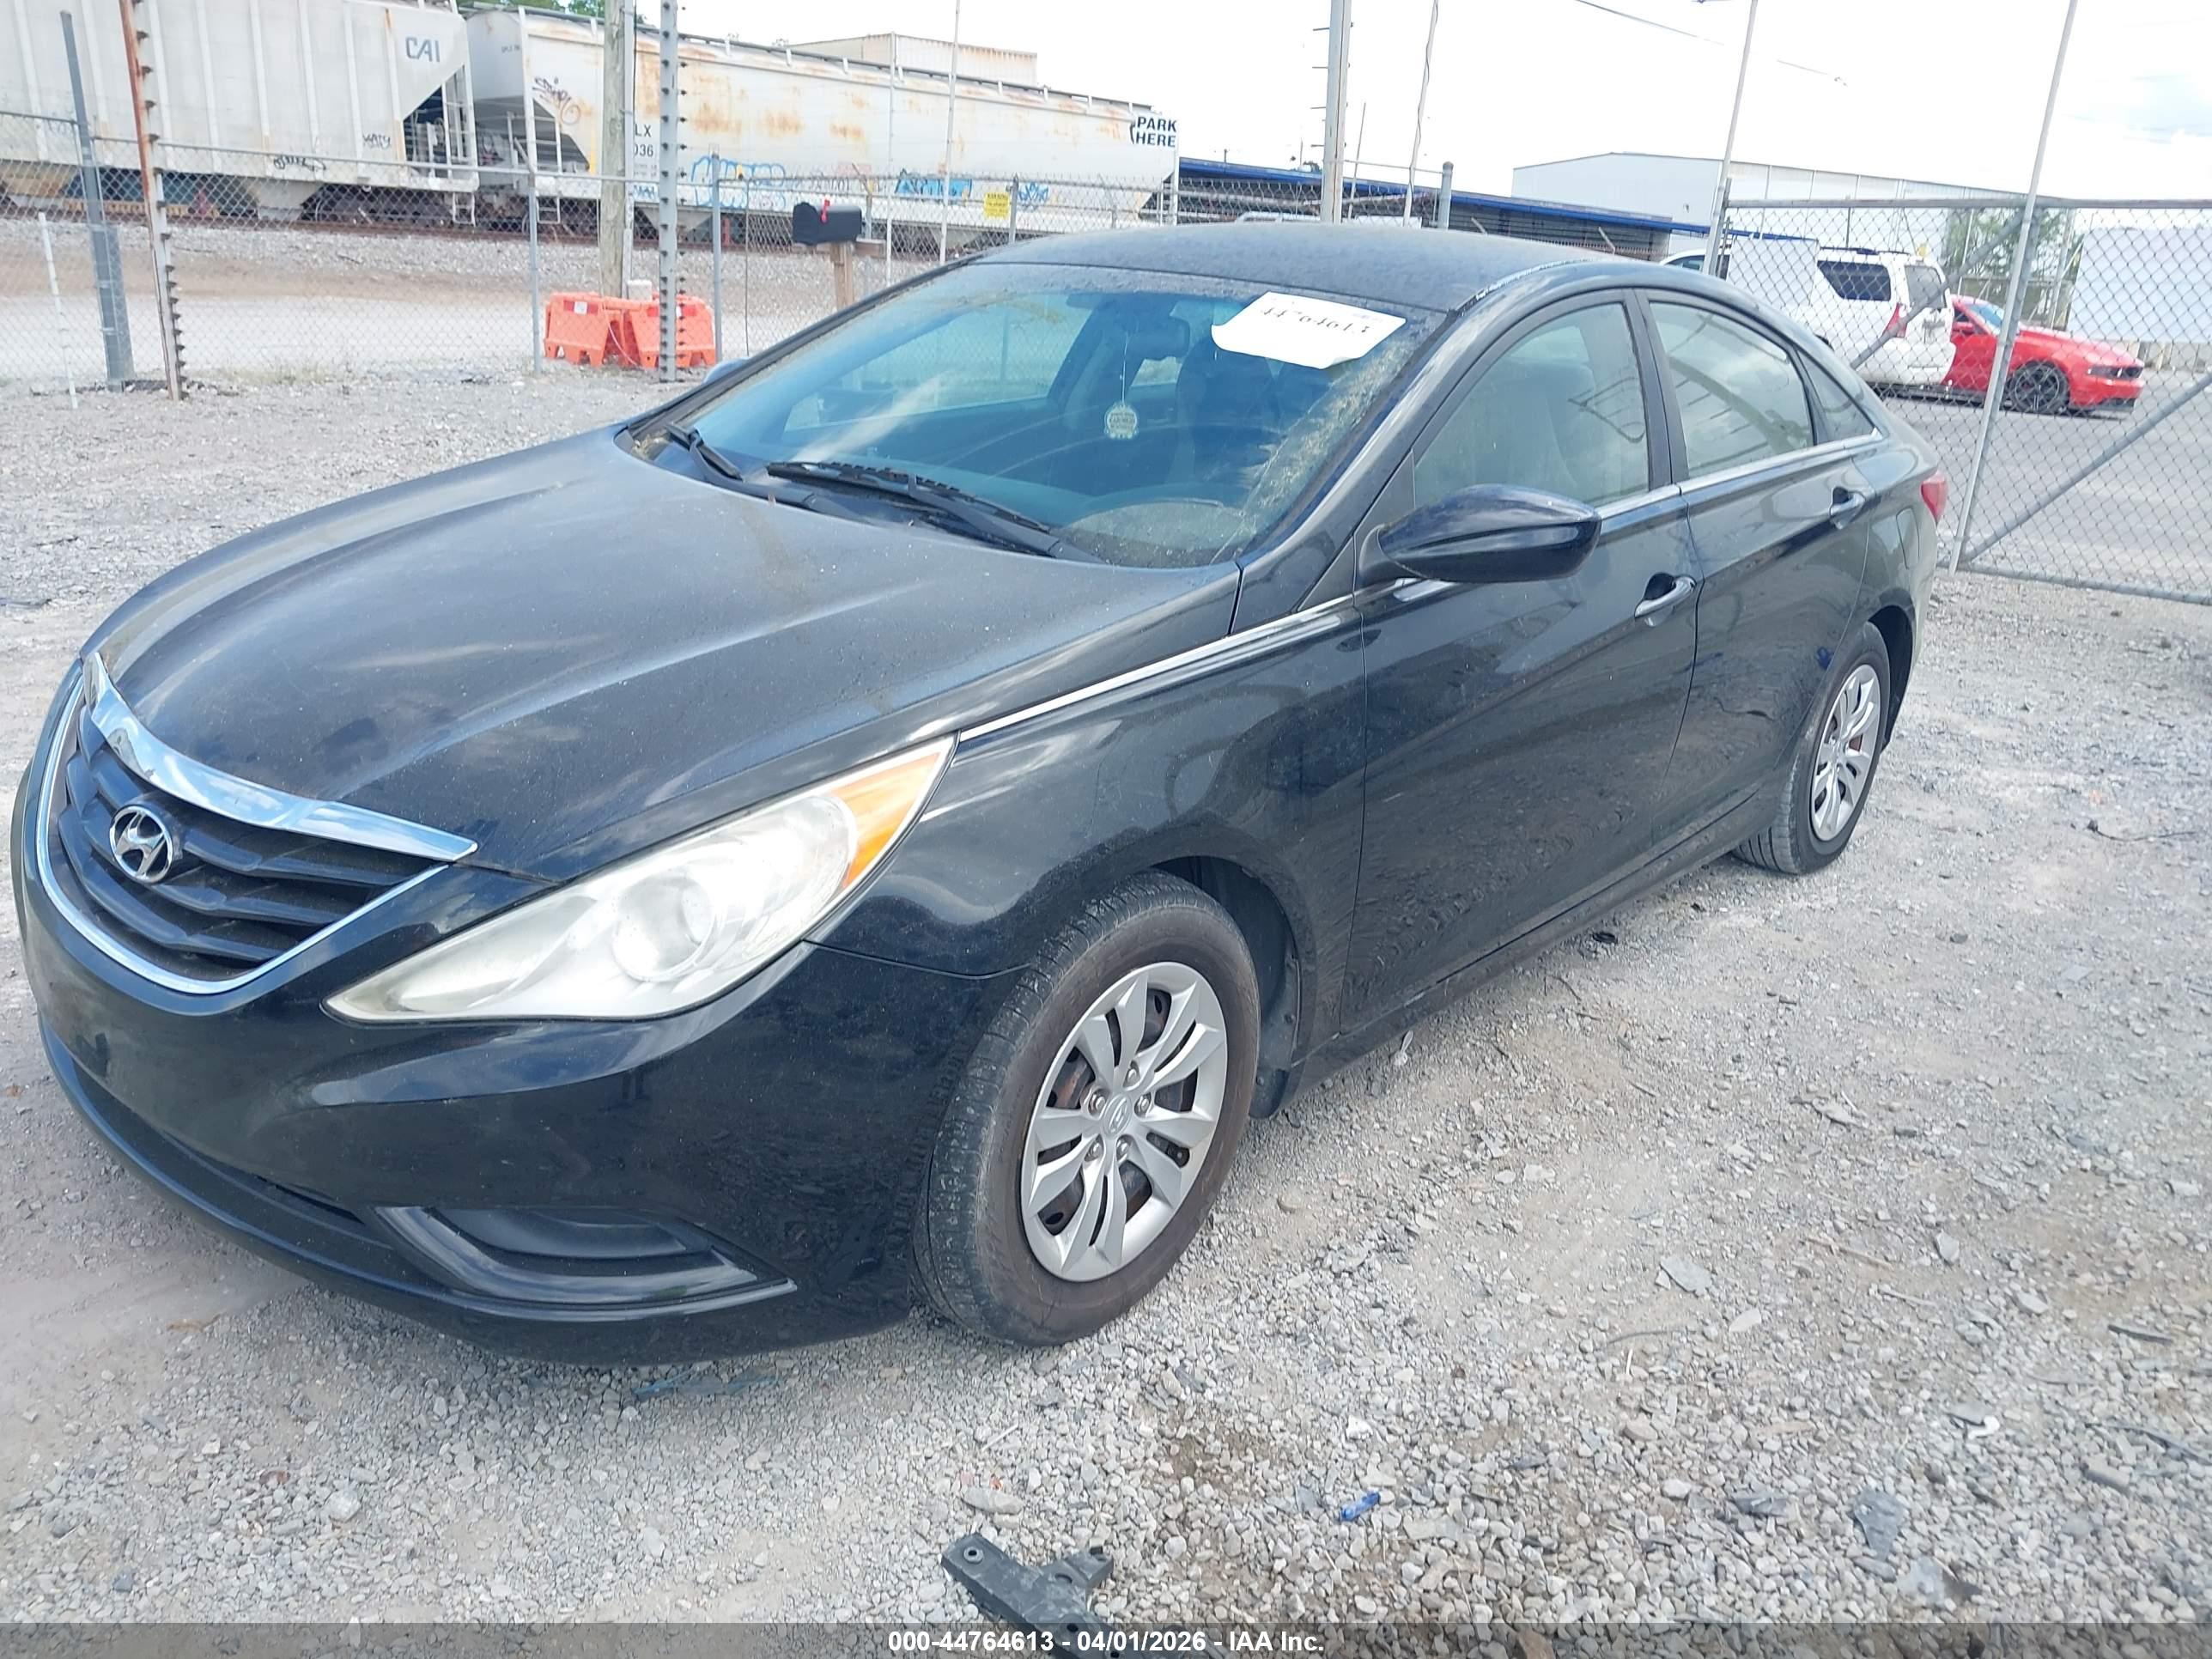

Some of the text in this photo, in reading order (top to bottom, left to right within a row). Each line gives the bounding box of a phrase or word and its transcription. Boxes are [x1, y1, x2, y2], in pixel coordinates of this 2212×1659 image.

[405, 37, 441, 63] CAI
[1137, 116, 1177, 132] PARK
[1135, 131, 1176, 148] HERE
